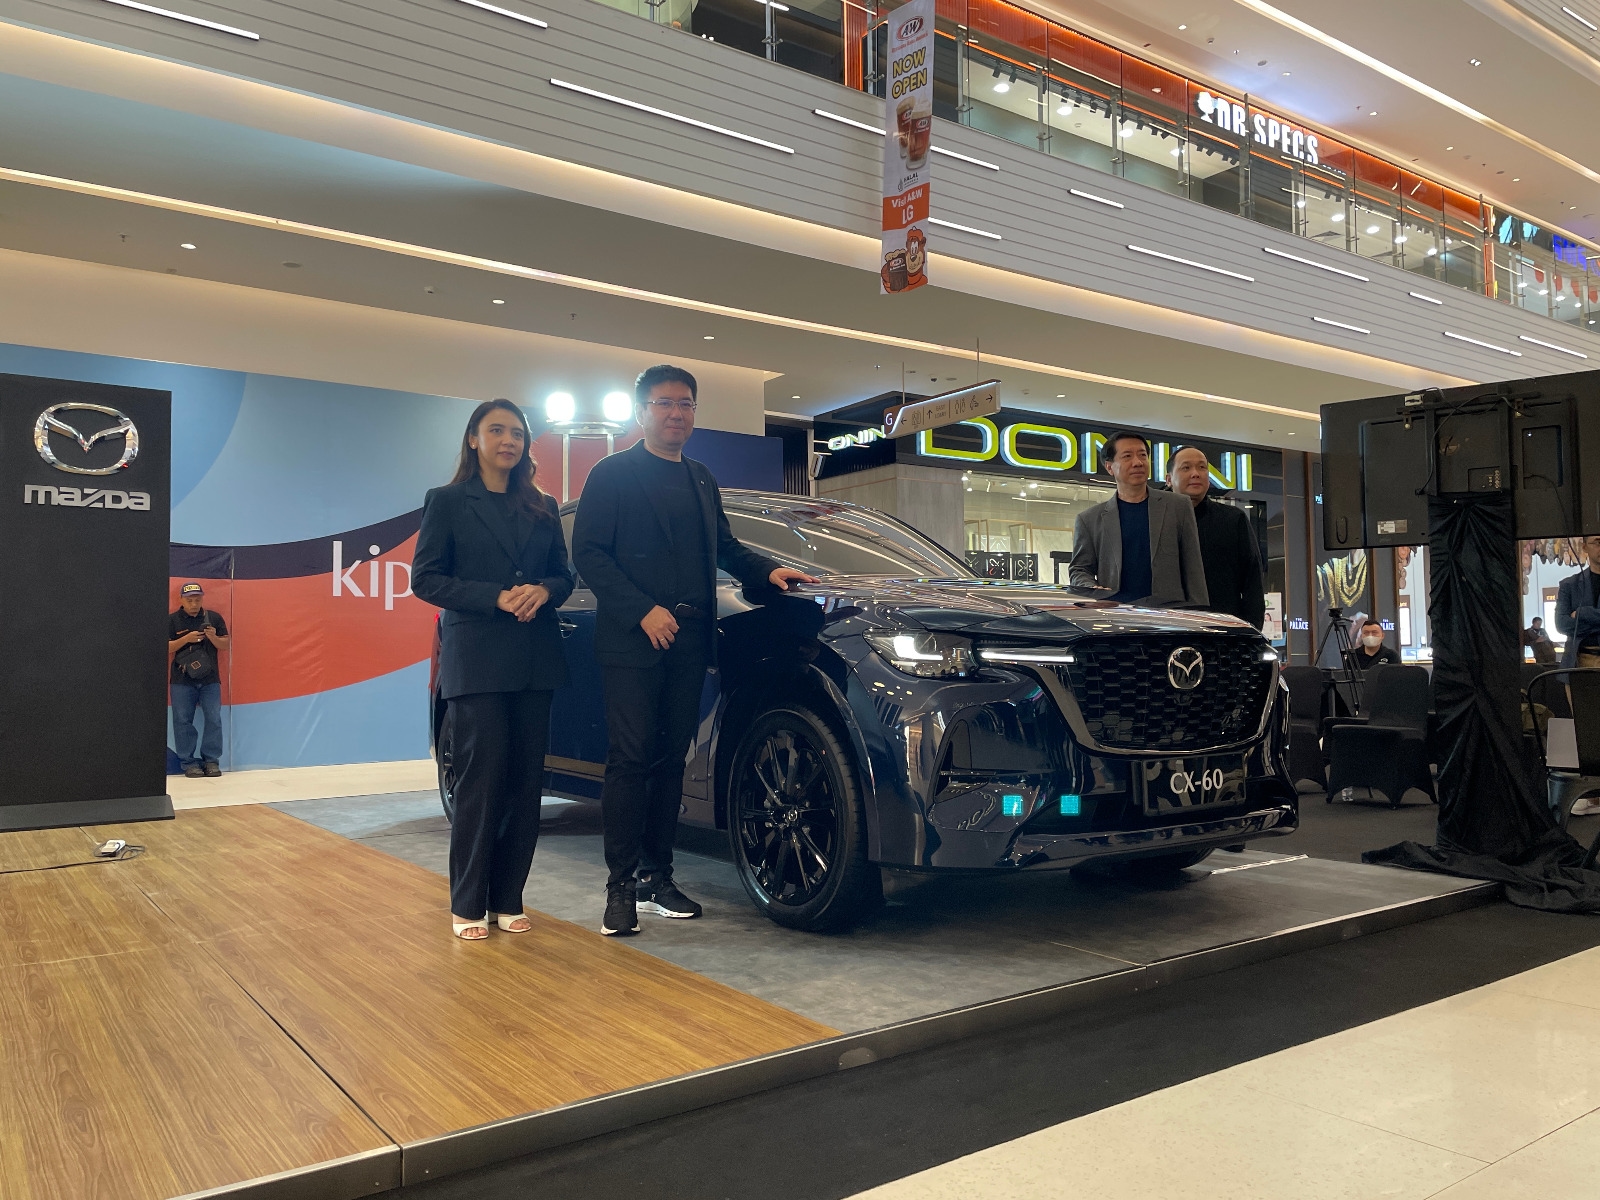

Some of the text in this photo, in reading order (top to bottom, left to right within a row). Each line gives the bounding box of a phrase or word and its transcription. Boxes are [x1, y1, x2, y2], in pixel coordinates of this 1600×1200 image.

[893, 46, 926, 78] NOW
[892, 68, 928, 99] OPEN
[1253, 113, 1319, 165] SPECS
[902, 204, 914, 225] LG
[885, 412, 893, 426] G
[332, 541, 413, 611] kip
[1170, 768, 1224, 794] CX-60
